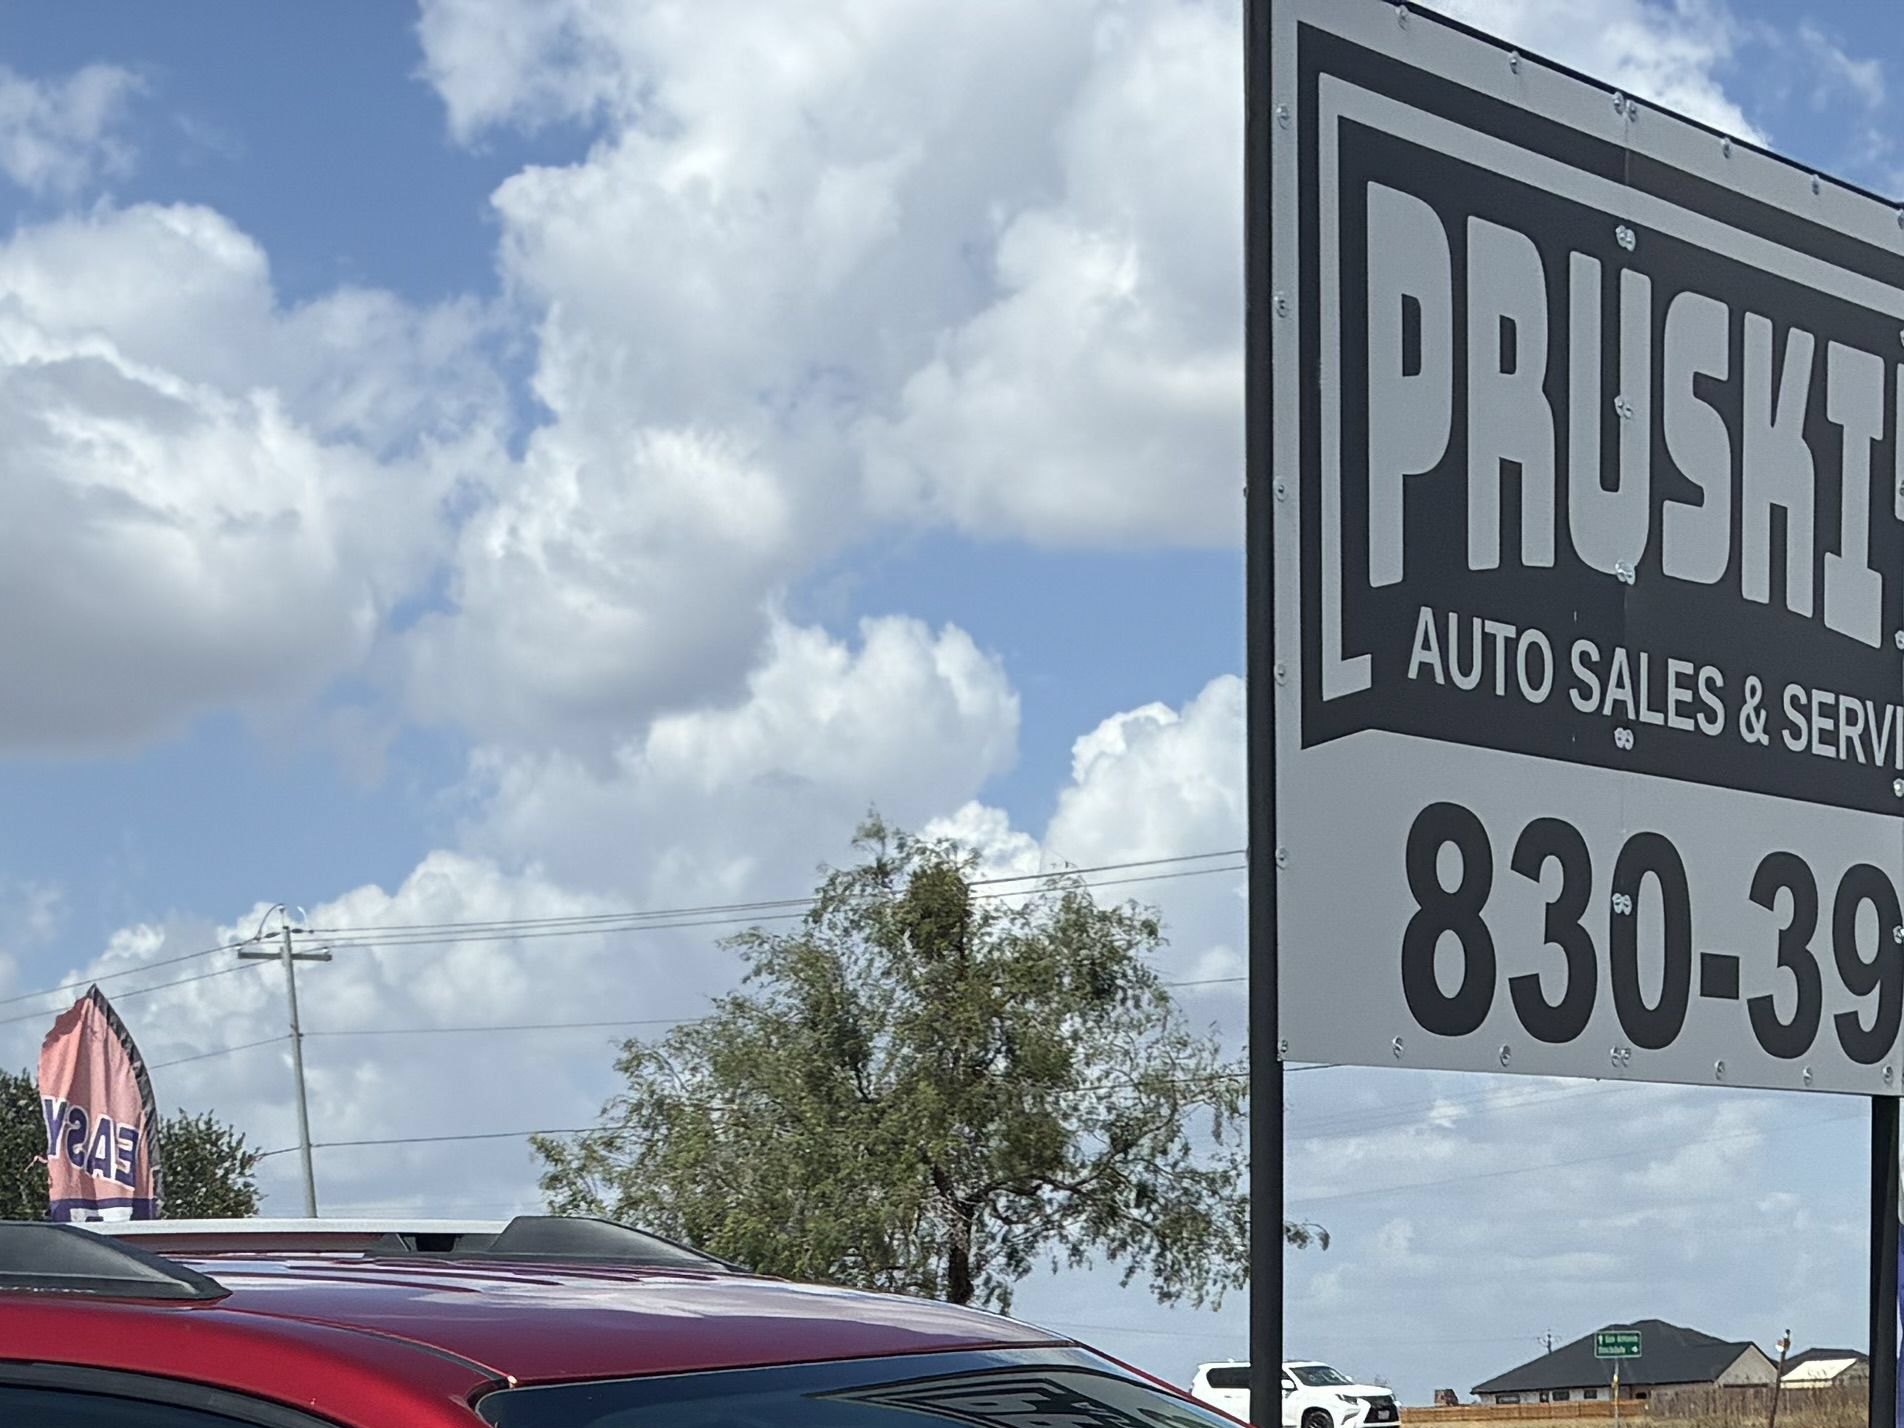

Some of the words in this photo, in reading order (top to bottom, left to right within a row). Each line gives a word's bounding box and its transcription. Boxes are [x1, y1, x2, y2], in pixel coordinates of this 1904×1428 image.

[1407, 605, 1554, 704] AUTO
[1568, 638, 1726, 737] SALES
[1738, 674, 1770, 746] &
